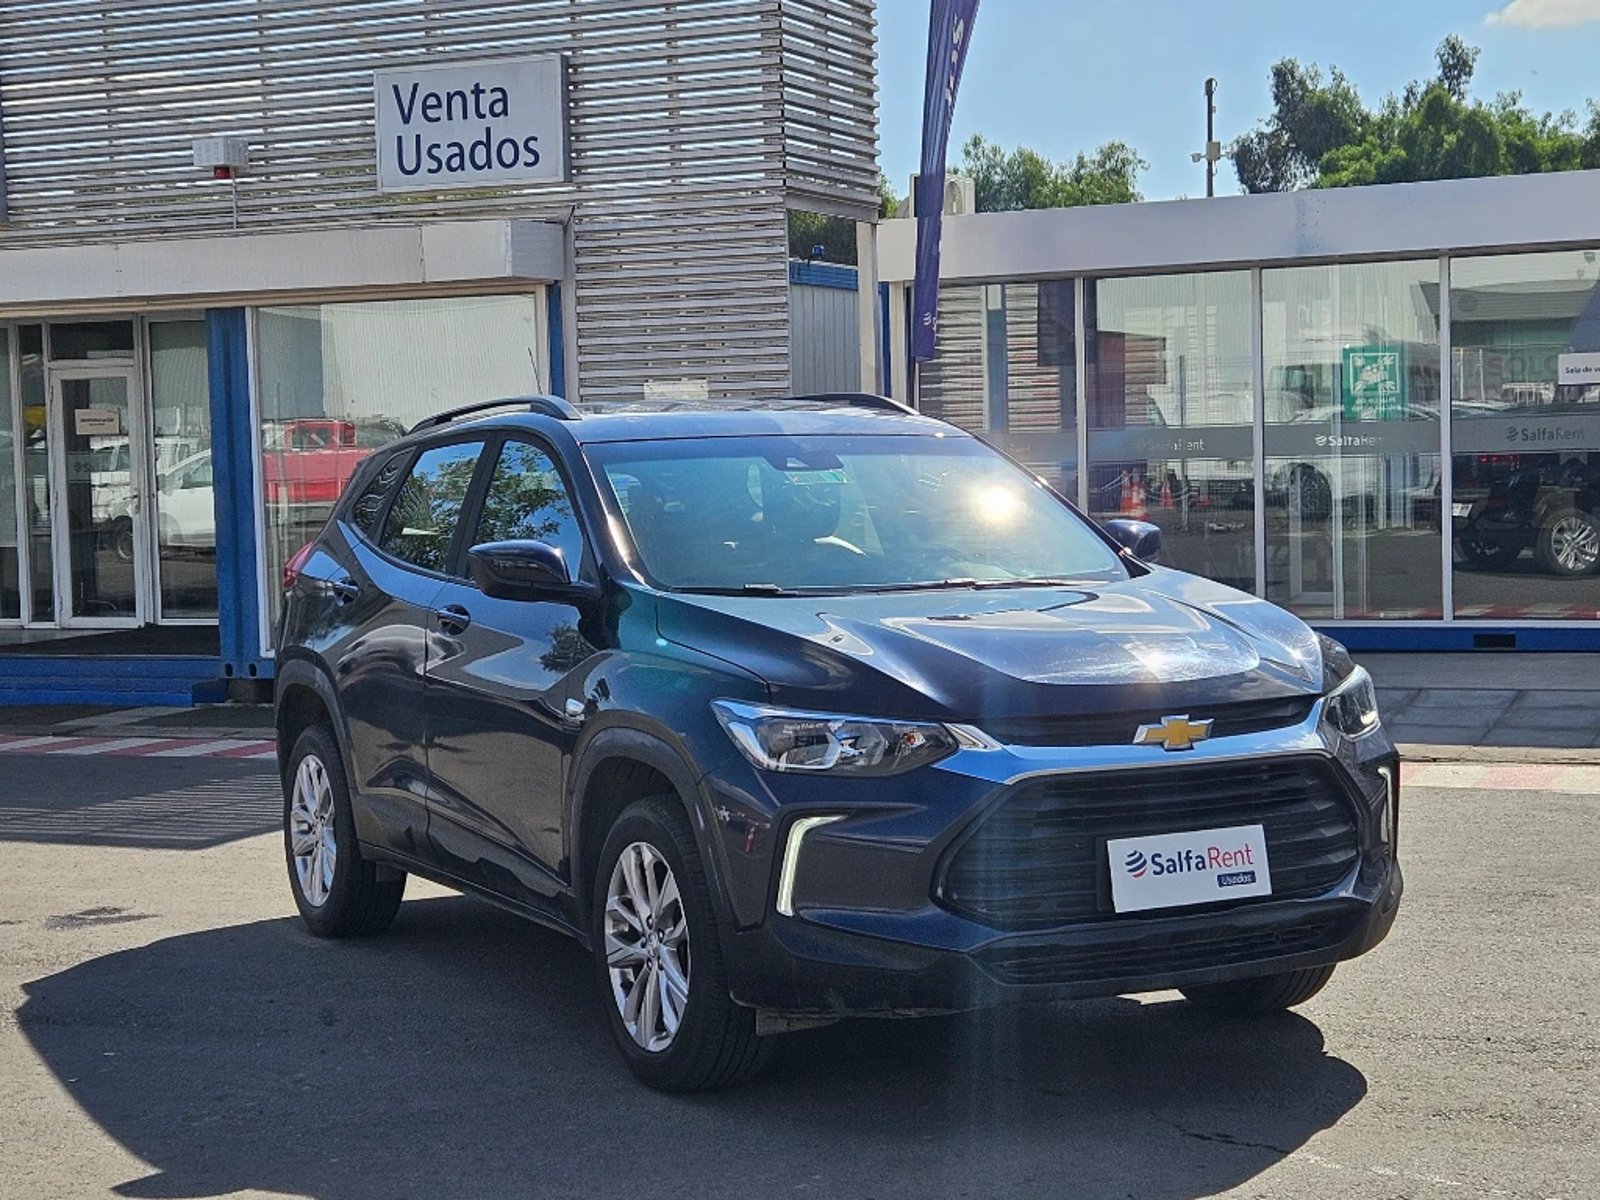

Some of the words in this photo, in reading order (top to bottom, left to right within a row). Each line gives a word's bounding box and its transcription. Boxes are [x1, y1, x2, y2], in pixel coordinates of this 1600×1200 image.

[392, 82, 509, 125] Venta
[396, 126, 540, 176] Usados
[1328, 434, 1386, 447] SalfaRe
[1521, 427, 1586, 441] SalfaRent
[1152, 843, 1254, 876] SalfaRent
[1221, 872, 1253, 885] Usados
